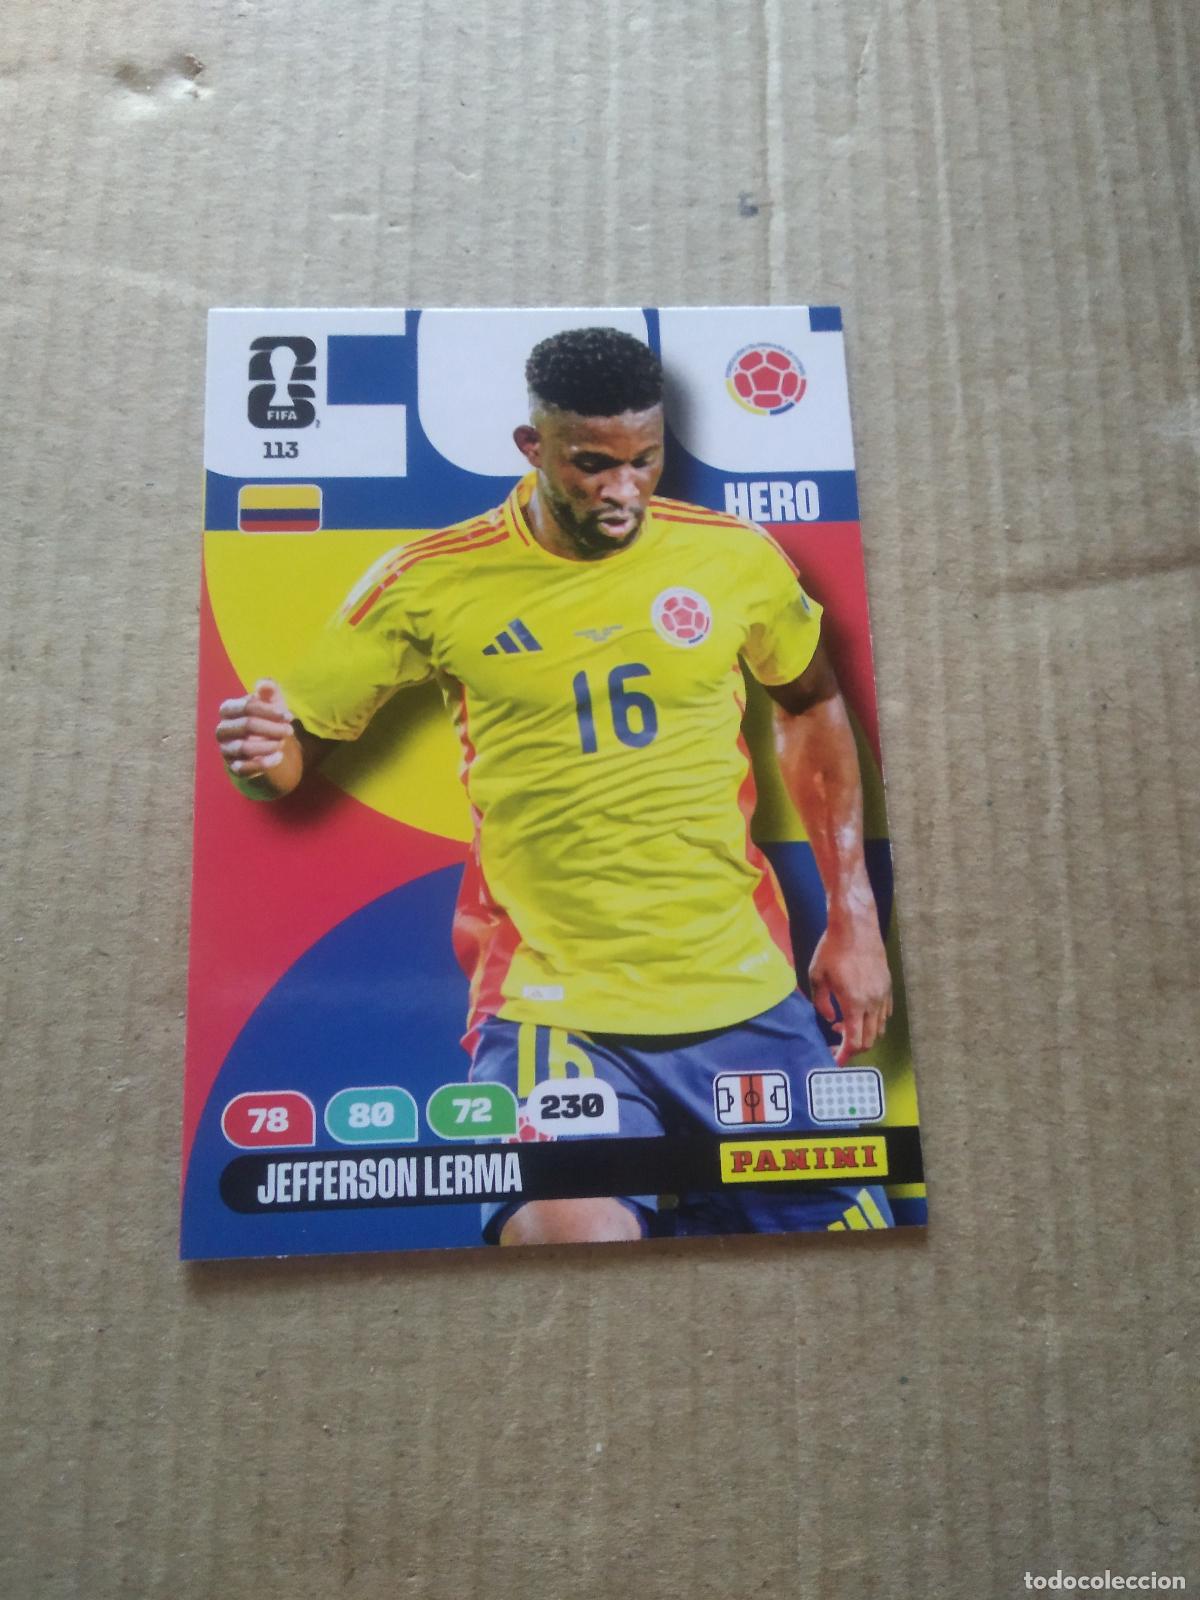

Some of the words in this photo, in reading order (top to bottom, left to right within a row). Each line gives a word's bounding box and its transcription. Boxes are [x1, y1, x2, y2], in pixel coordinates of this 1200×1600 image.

[266, 410, 298, 421] FIFA
[263, 441, 299, 459] 113
[724, 480, 820, 522] HERO
[572, 662, 658, 754] 16
[348, 1102, 395, 1128] 80
[452, 1097, 492, 1124] 72
[540, 1093, 605, 1120] 230
[248, 1107, 289, 1134] 78
[730, 1145, 878, 1174] PANINI
[257, 1157, 418, 1204] JEFFERSON
[424, 1152, 523, 1196] LERMA
